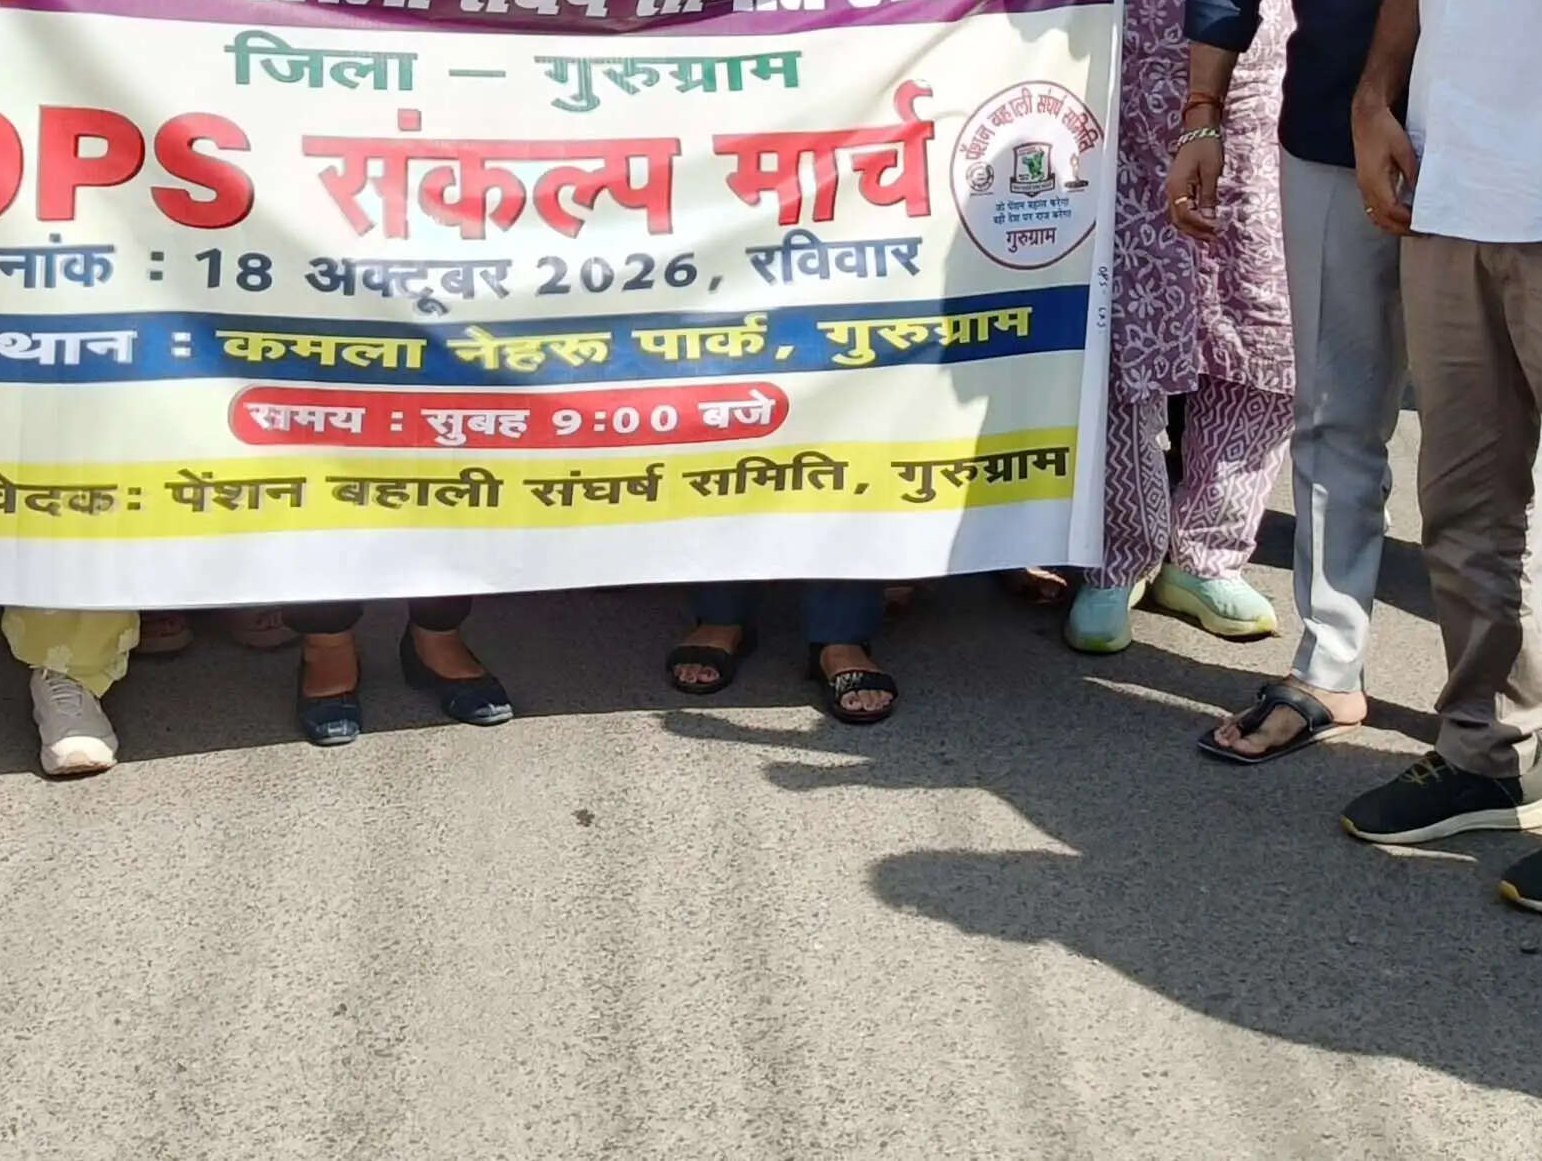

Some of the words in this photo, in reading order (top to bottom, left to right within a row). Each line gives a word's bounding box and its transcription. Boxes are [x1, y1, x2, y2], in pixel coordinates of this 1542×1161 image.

[224, 30, 418, 92] जिला
[534, 51, 802, 114] गुरुग्राम
[302, 109, 680, 240] संकल्प
[713, 79, 935, 227] मार्च
[194, 247, 273, 292] 18
[305, 256, 513, 317] अक्टूबर
[536, 251, 723, 296] 2026,
[746, 229, 923, 287] रविवार
[1006, 227, 1058, 253] गुरुग्राम
[215, 330, 428, 370] कमला
[447, 325, 613, 373] नेहरू
[632, 313, 794, 363] पार्क,
[817, 306, 1034, 368] गुरुग्राम
[245, 402, 366, 435] समय
[420, 407, 530, 446] सुबह
[551, 405, 680, 437] 9:00
[698, 390, 778, 430] बजे
[164, 468, 307, 513] पेंशन
[325, 467, 504, 509] बहाली
[523, 463, 664, 506] संघर्ष
[682, 450, 870, 498] समिति,
[891, 446, 1069, 504] गुरुग्राम
